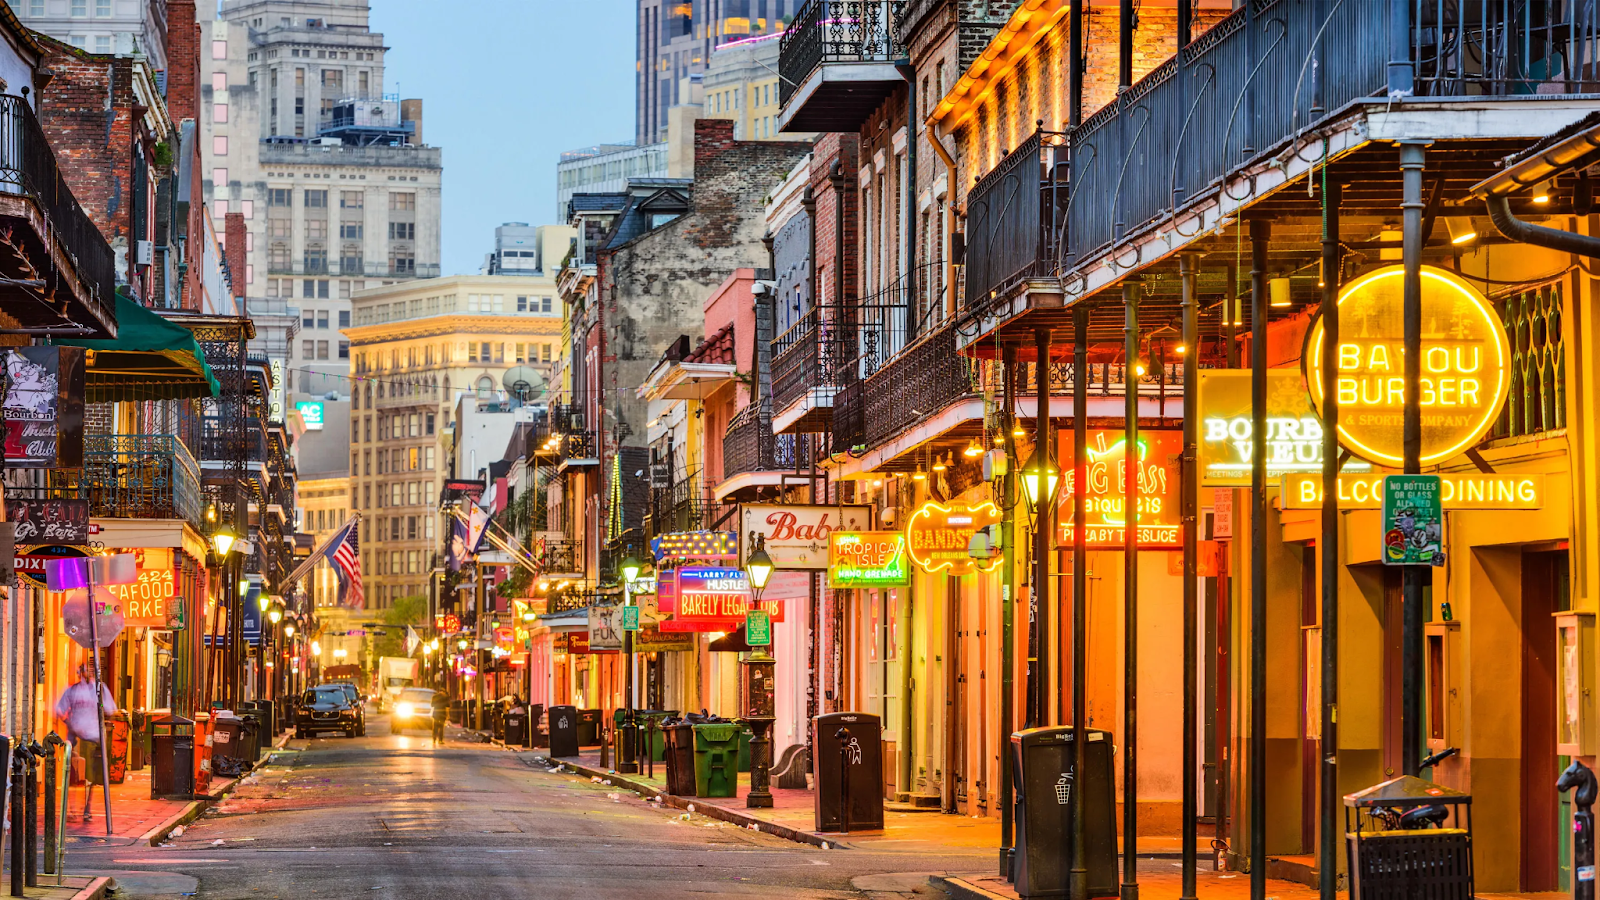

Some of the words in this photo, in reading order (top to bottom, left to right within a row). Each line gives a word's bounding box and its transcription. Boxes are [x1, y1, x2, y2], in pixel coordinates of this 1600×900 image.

[1338, 344, 1479, 373] BAOU
[301, 405, 321, 417] AC
[1345, 415, 1355, 425] &
[1420, 413, 1473, 427] OMPANY
[1390, 482, 1401, 490] NO
[1404, 482, 1436, 490] BOTTLES
[1394, 491, 1404, 499] OR
[1407, 491, 1432, 499] GLASS
[1142, 529, 1177, 542] SLICE
[857, 554, 885, 566] ISLE
[137, 570, 173, 583] 424
[707, 579, 749, 590] HUSTLER
[681, 594, 719, 615] BARELY
